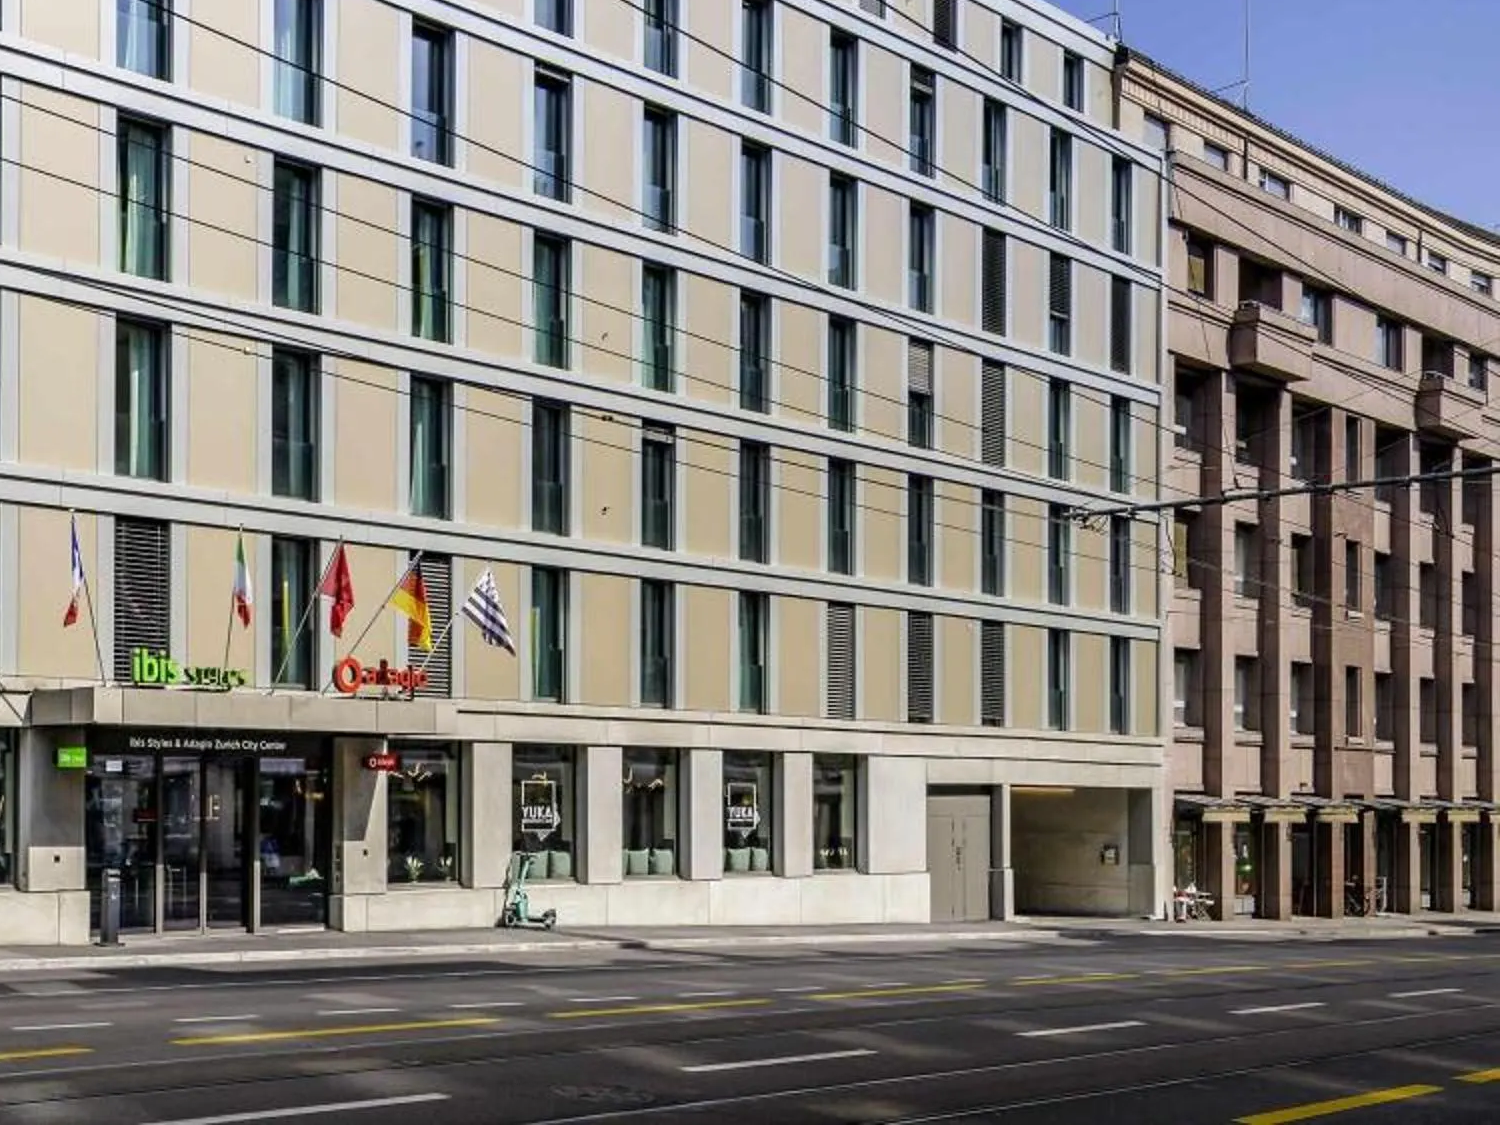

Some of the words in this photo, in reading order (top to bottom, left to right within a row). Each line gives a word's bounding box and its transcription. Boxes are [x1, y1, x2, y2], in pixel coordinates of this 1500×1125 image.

[132, 647, 180, 683] ibis
[522, 806, 553, 818] YUKA
[728, 807, 753, 818] YUKA
